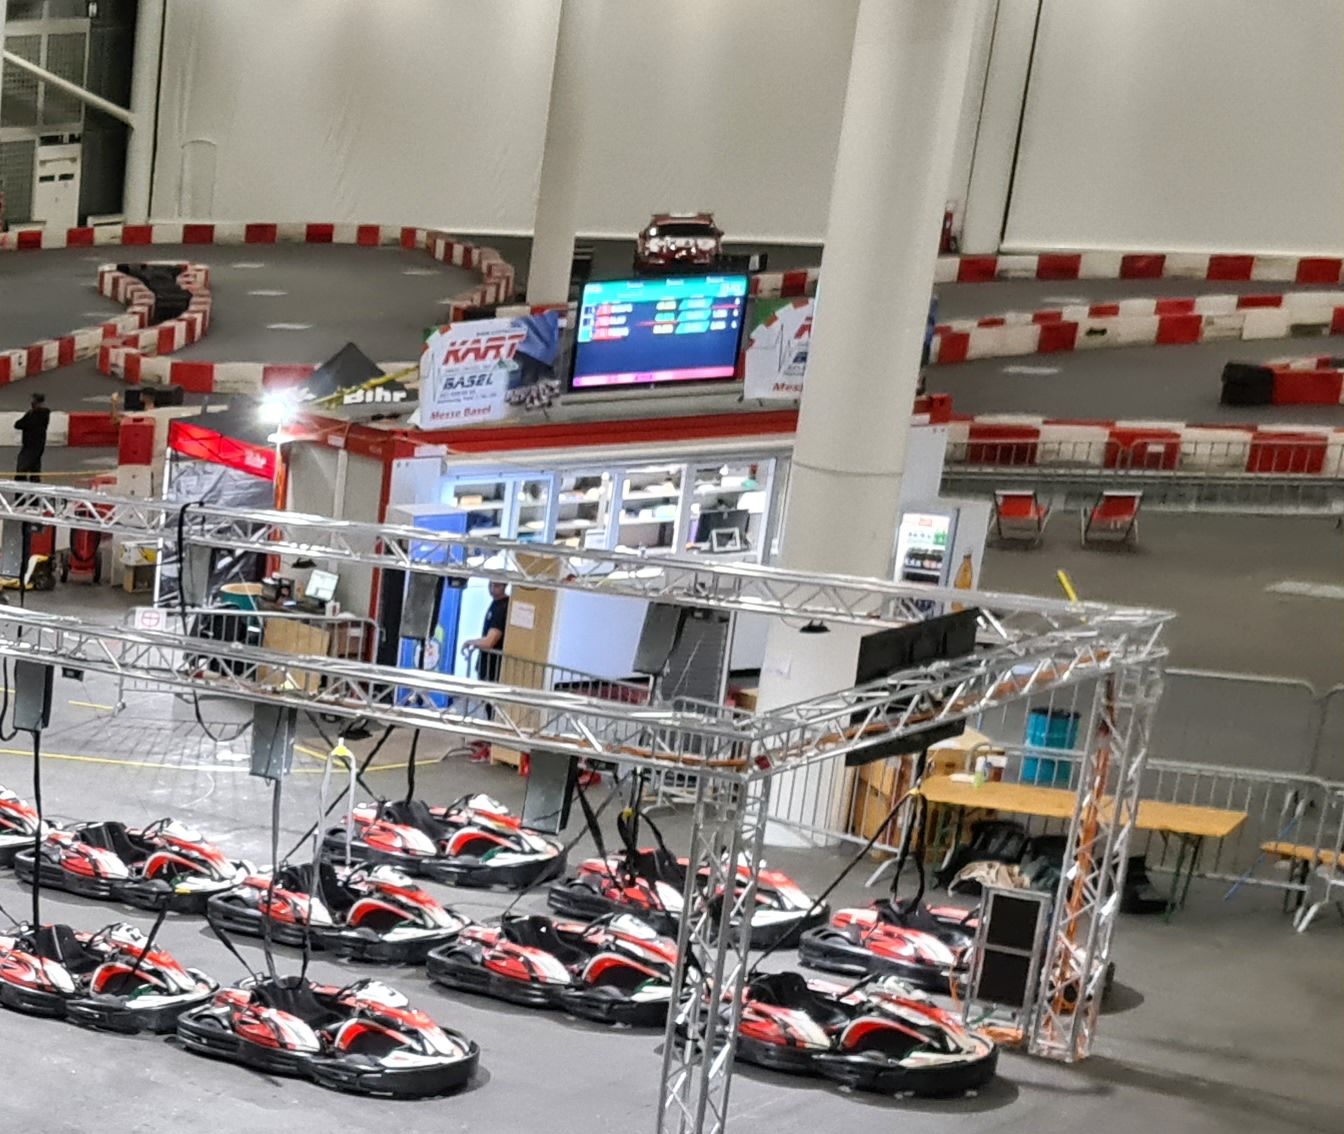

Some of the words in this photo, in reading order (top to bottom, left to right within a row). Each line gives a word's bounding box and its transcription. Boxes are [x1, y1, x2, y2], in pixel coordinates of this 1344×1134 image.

[442, 333, 527, 365] KART
[443, 373, 494, 391] BASEL
[430, 409, 461, 421] Messe
[464, 405, 492, 418] Basel
